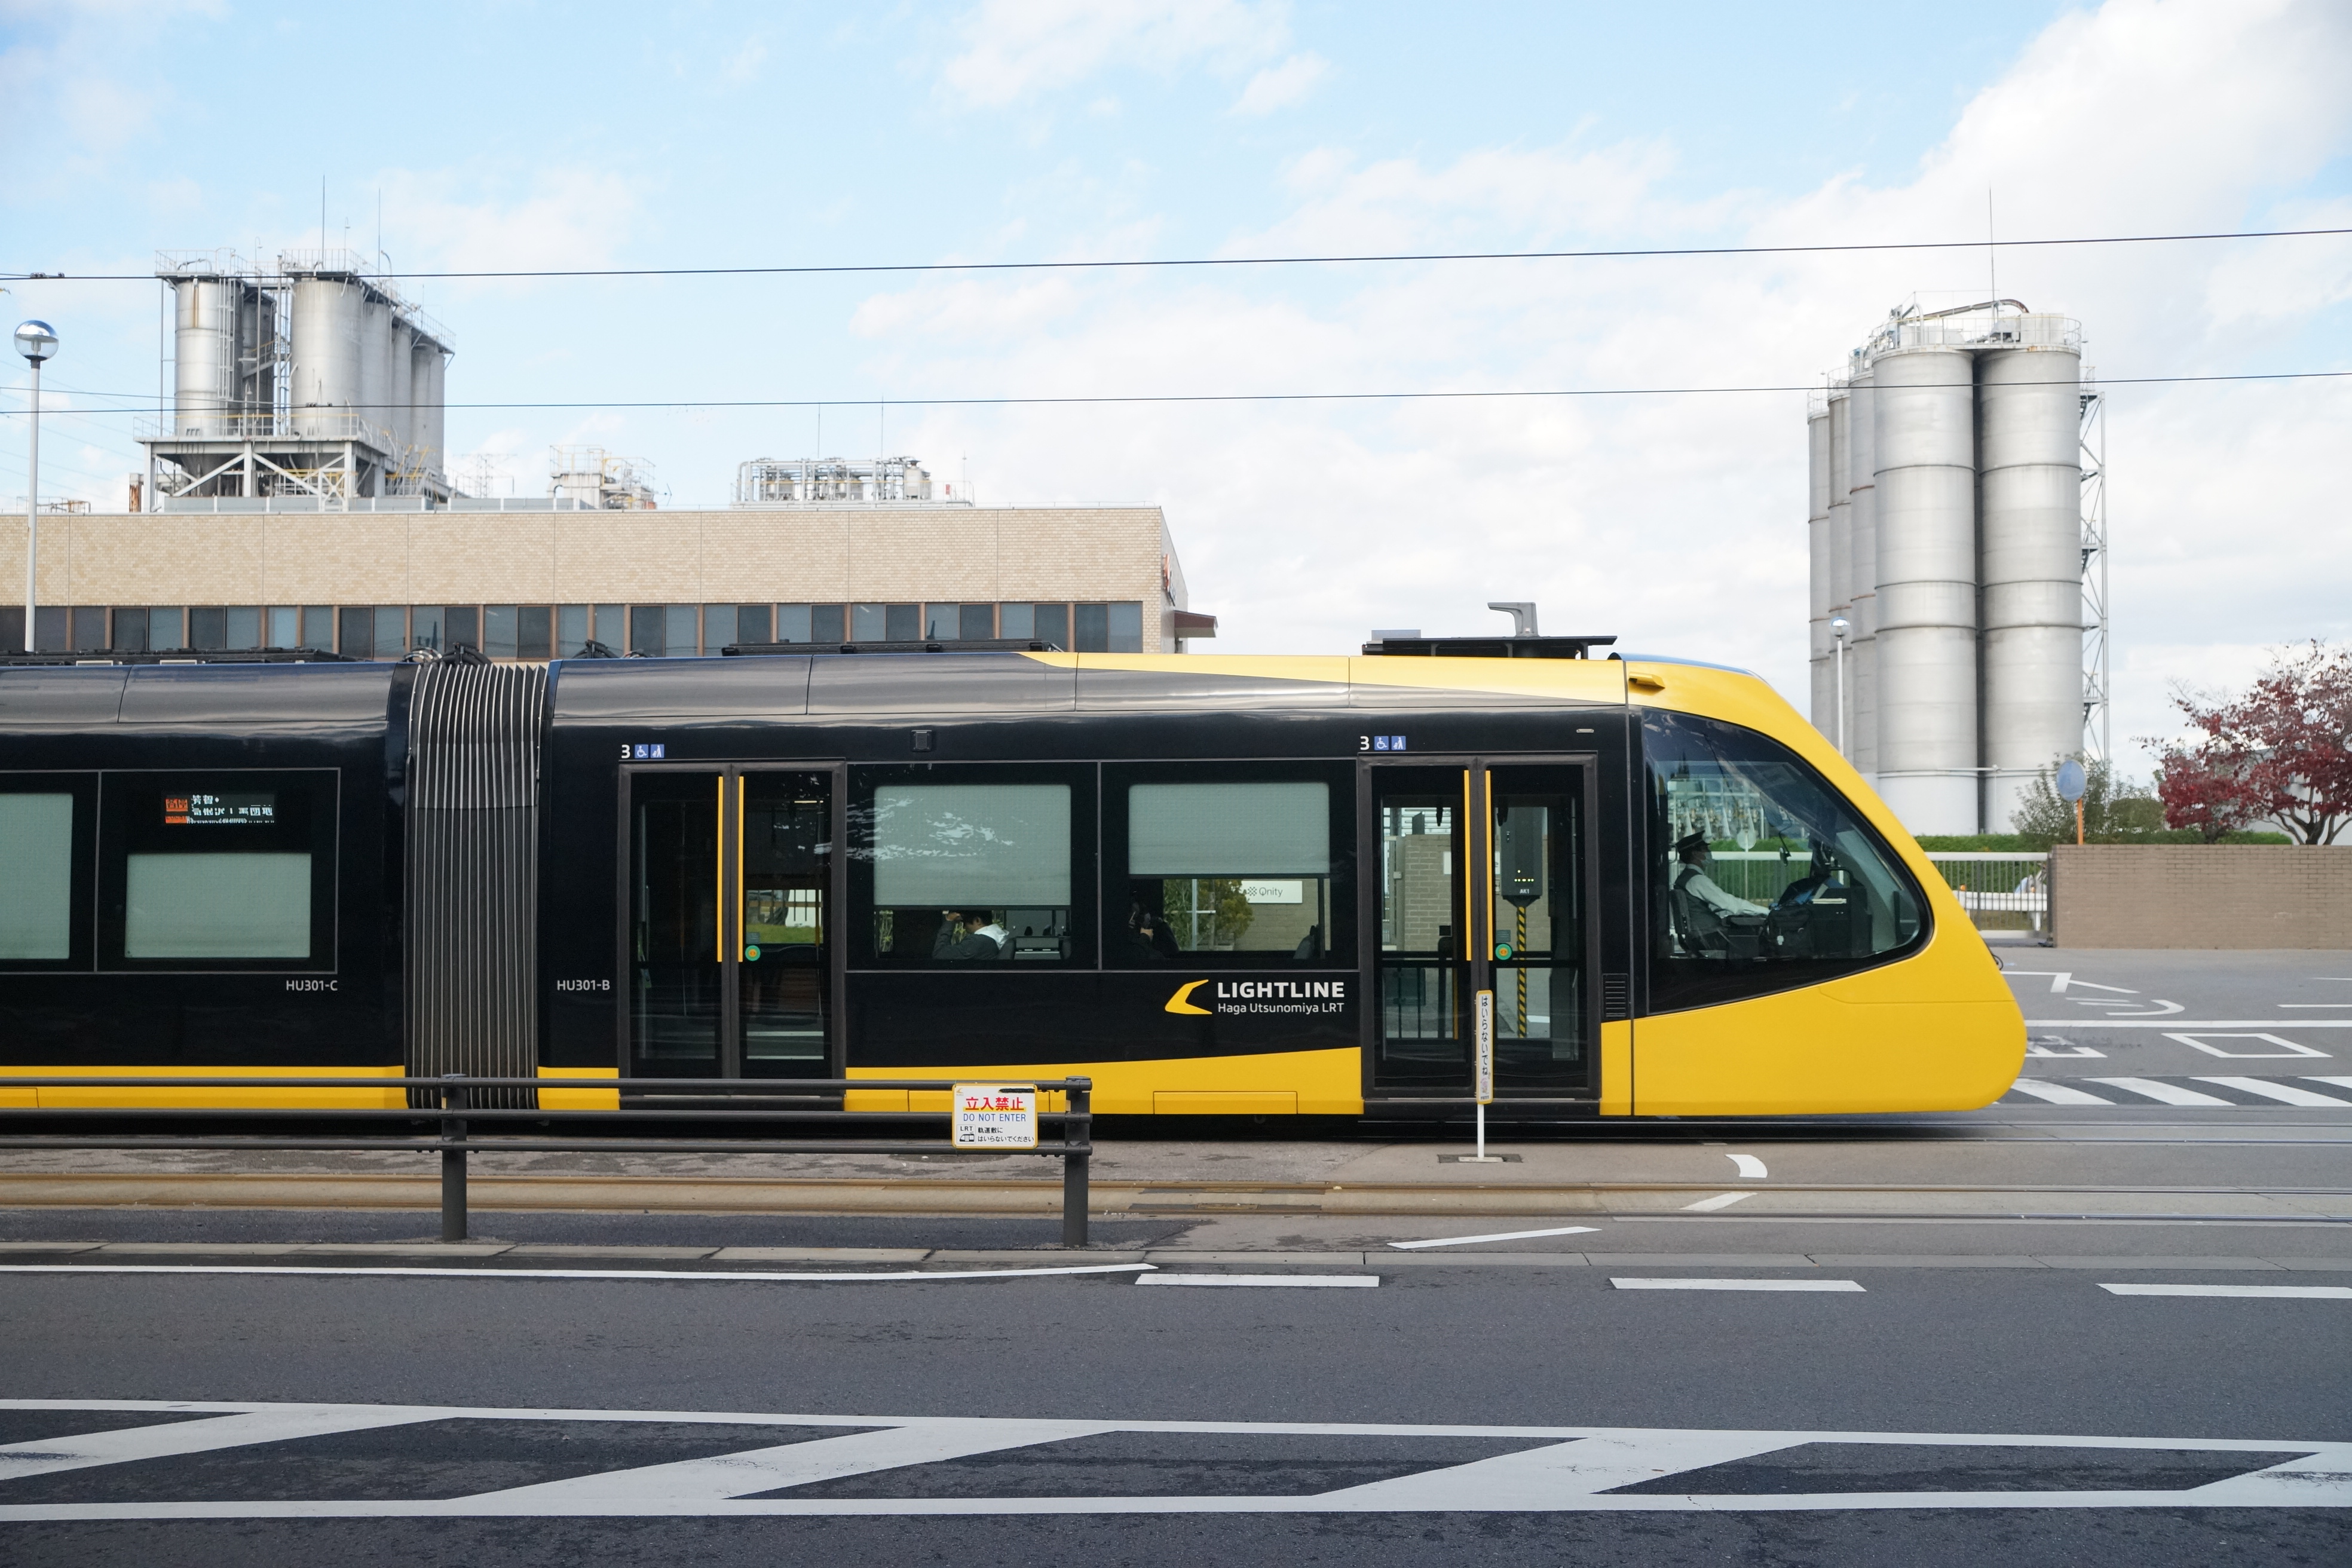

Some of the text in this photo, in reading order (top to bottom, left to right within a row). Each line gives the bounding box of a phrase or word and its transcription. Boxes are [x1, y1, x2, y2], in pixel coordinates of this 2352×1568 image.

[1360, 736, 1370, 751] 3
[621, 744, 630, 759] 3
[1258, 887, 1283, 898] Qnity
[286, 980, 338, 991] HU301-C
[557, 979, 610, 991] HU301-B
[1217, 982, 1345, 998] LIGHTLINE
[1218, 1003, 1345, 1015] Haga Utsunomiya LRT
[965, 1097, 1024, 1111] 立入禁止
[963, 1113, 1026, 1122] DO NOT ENTER
